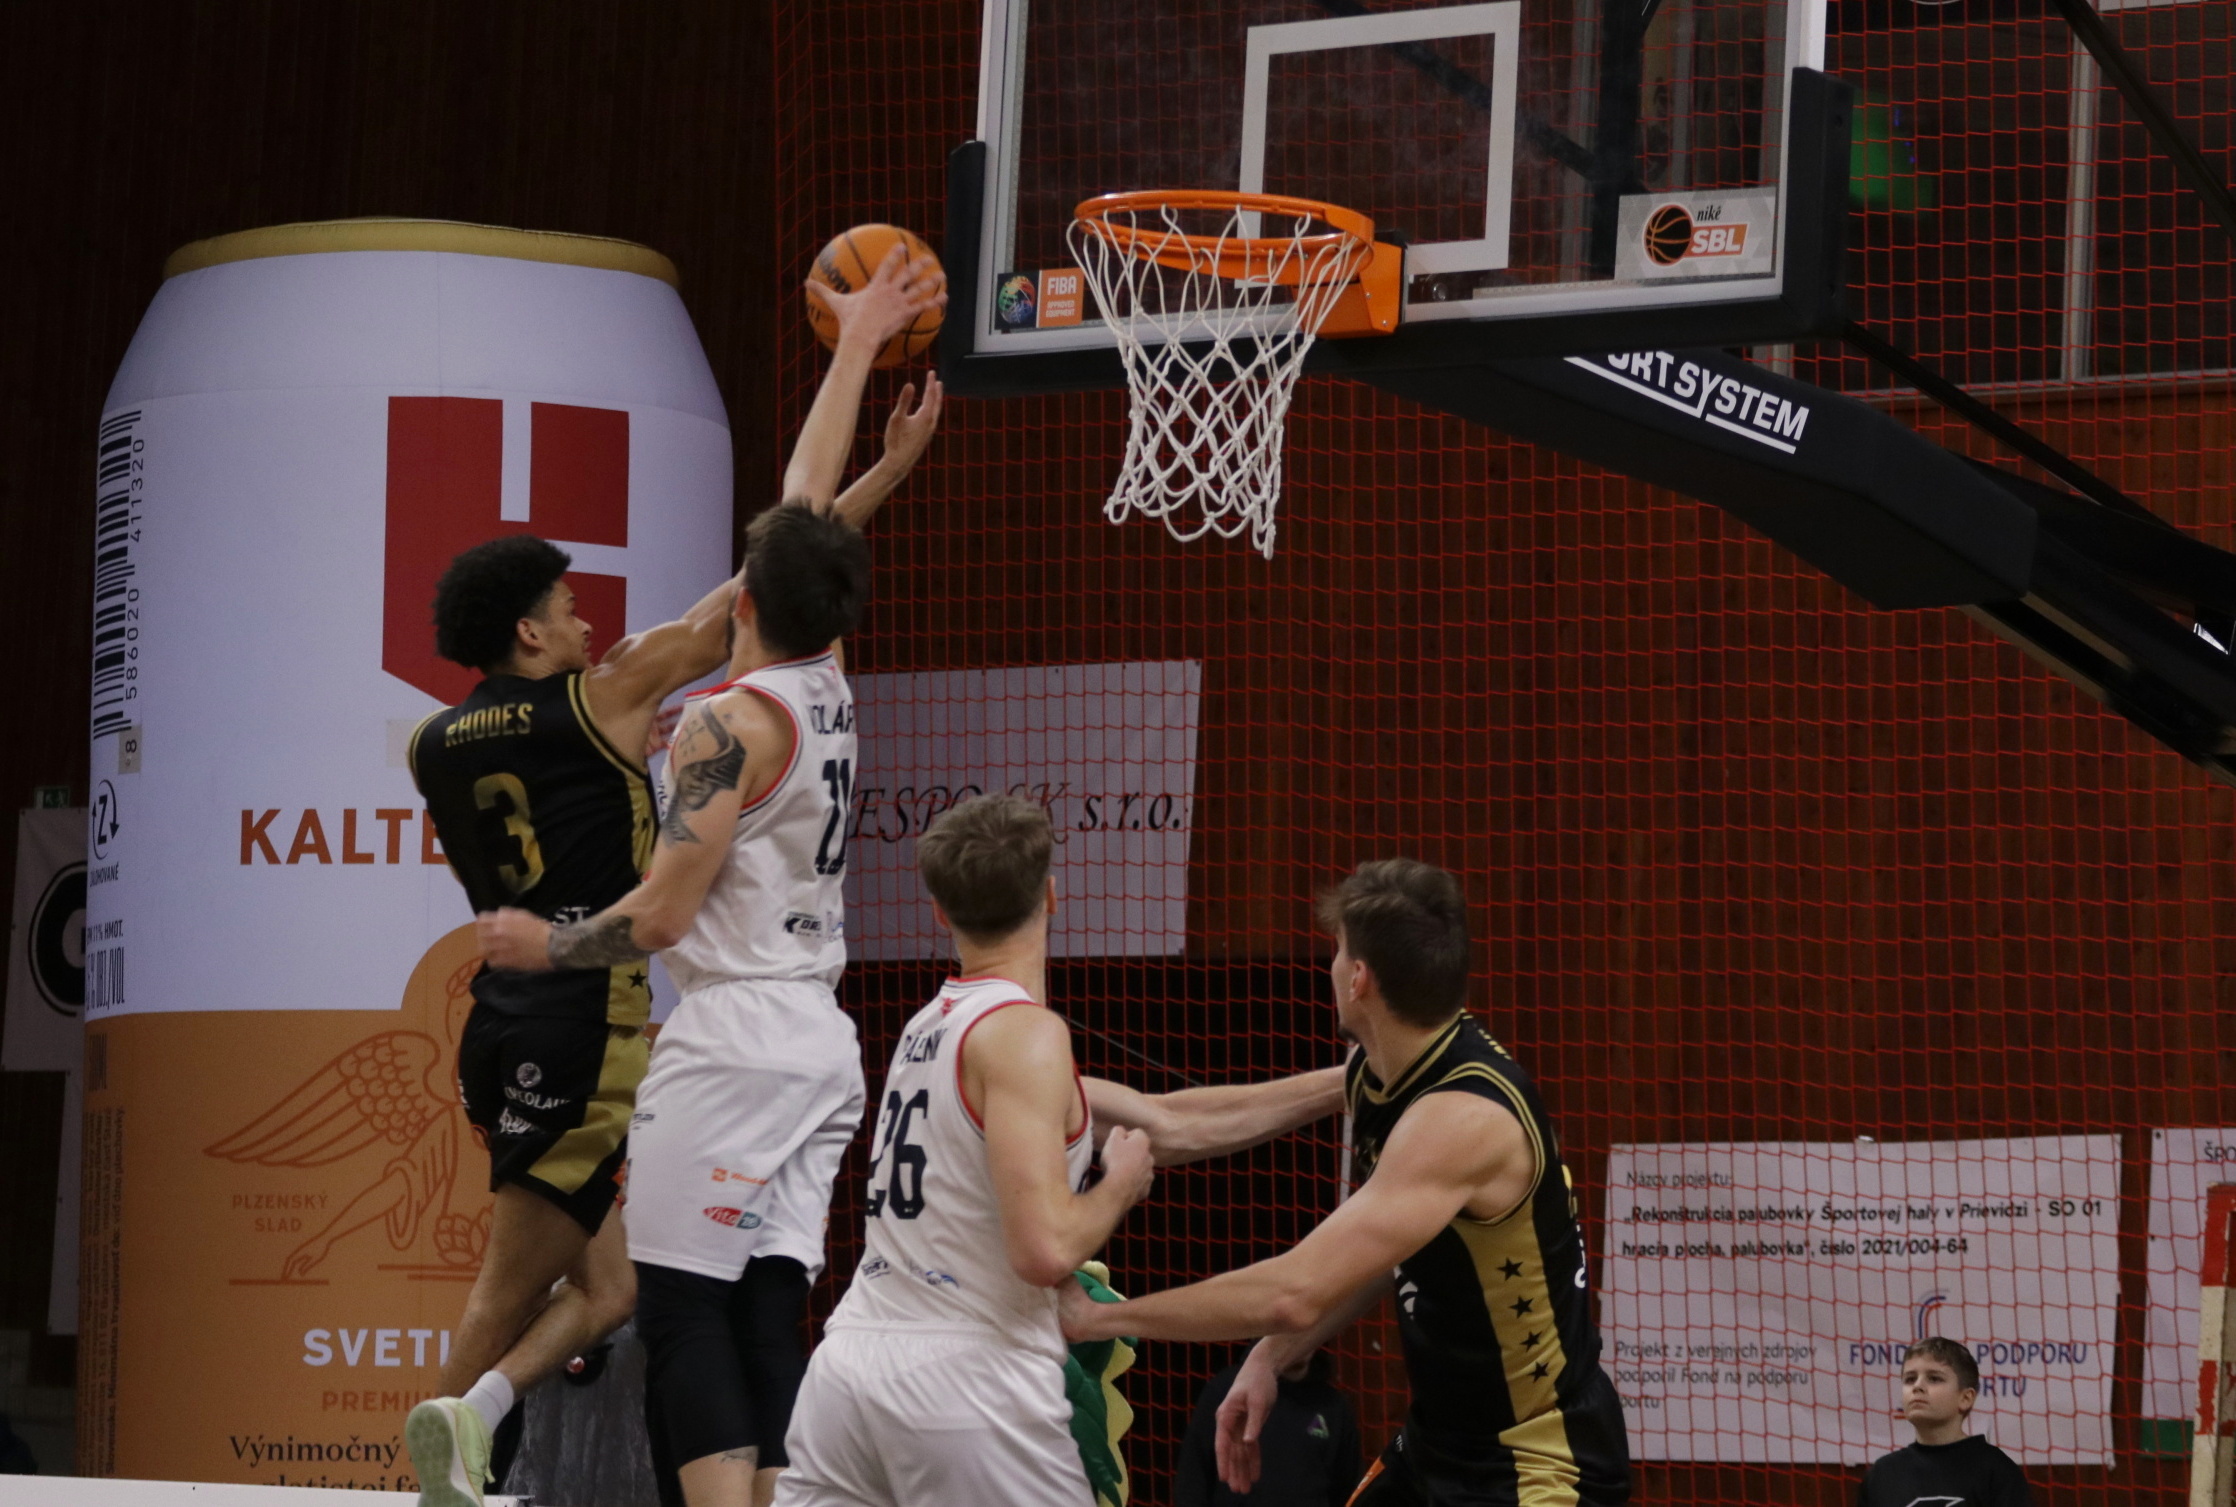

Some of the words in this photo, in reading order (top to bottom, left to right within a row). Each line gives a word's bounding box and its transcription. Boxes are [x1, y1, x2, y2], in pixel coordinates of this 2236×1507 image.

[1691, 228, 1742, 254] SBL
[1047, 275, 1077, 296] FIBA
[1045, 308, 1075, 318] EQUIPMENT
[1047, 300, 1075, 309] APPROVED
[1673, 361, 1810, 441] SYSTEM
[445, 702, 533, 748] RHODES
[1078, 791, 1181, 833] s.r.o.
[473, 772, 545, 893] 3
[864, 1088, 929, 1220] 26
[1737, 1204, 1814, 1225] palubovky
[1821, 1202, 1901, 1225] Športovej
[1907, 1204, 1939, 1225] haly
[1945, 1207, 1955, 1219] v
[1960, 1201, 2028, 1219] Prievidzi
[2049, 1201, 2075, 1217] SO
[2082, 1200, 2102, 1217] 01
[254, 1218, 302, 1233] SLAD
[1622, 1240, 1669, 1256] hracia
[1862, 1237, 1968, 1256] 2021/004-64
[1616, 1341, 1669, 1360] Projekt
[1675, 1346, 1683, 1358] z
[1977, 1343, 2087, 1366] PODPORU
[1681, 1367, 1719, 1384] Fond
[1724, 1370, 1741, 1384] na
[1747, 1368, 1809, 1388] podporu
[229, 1434, 400, 1469] Výnimočný
